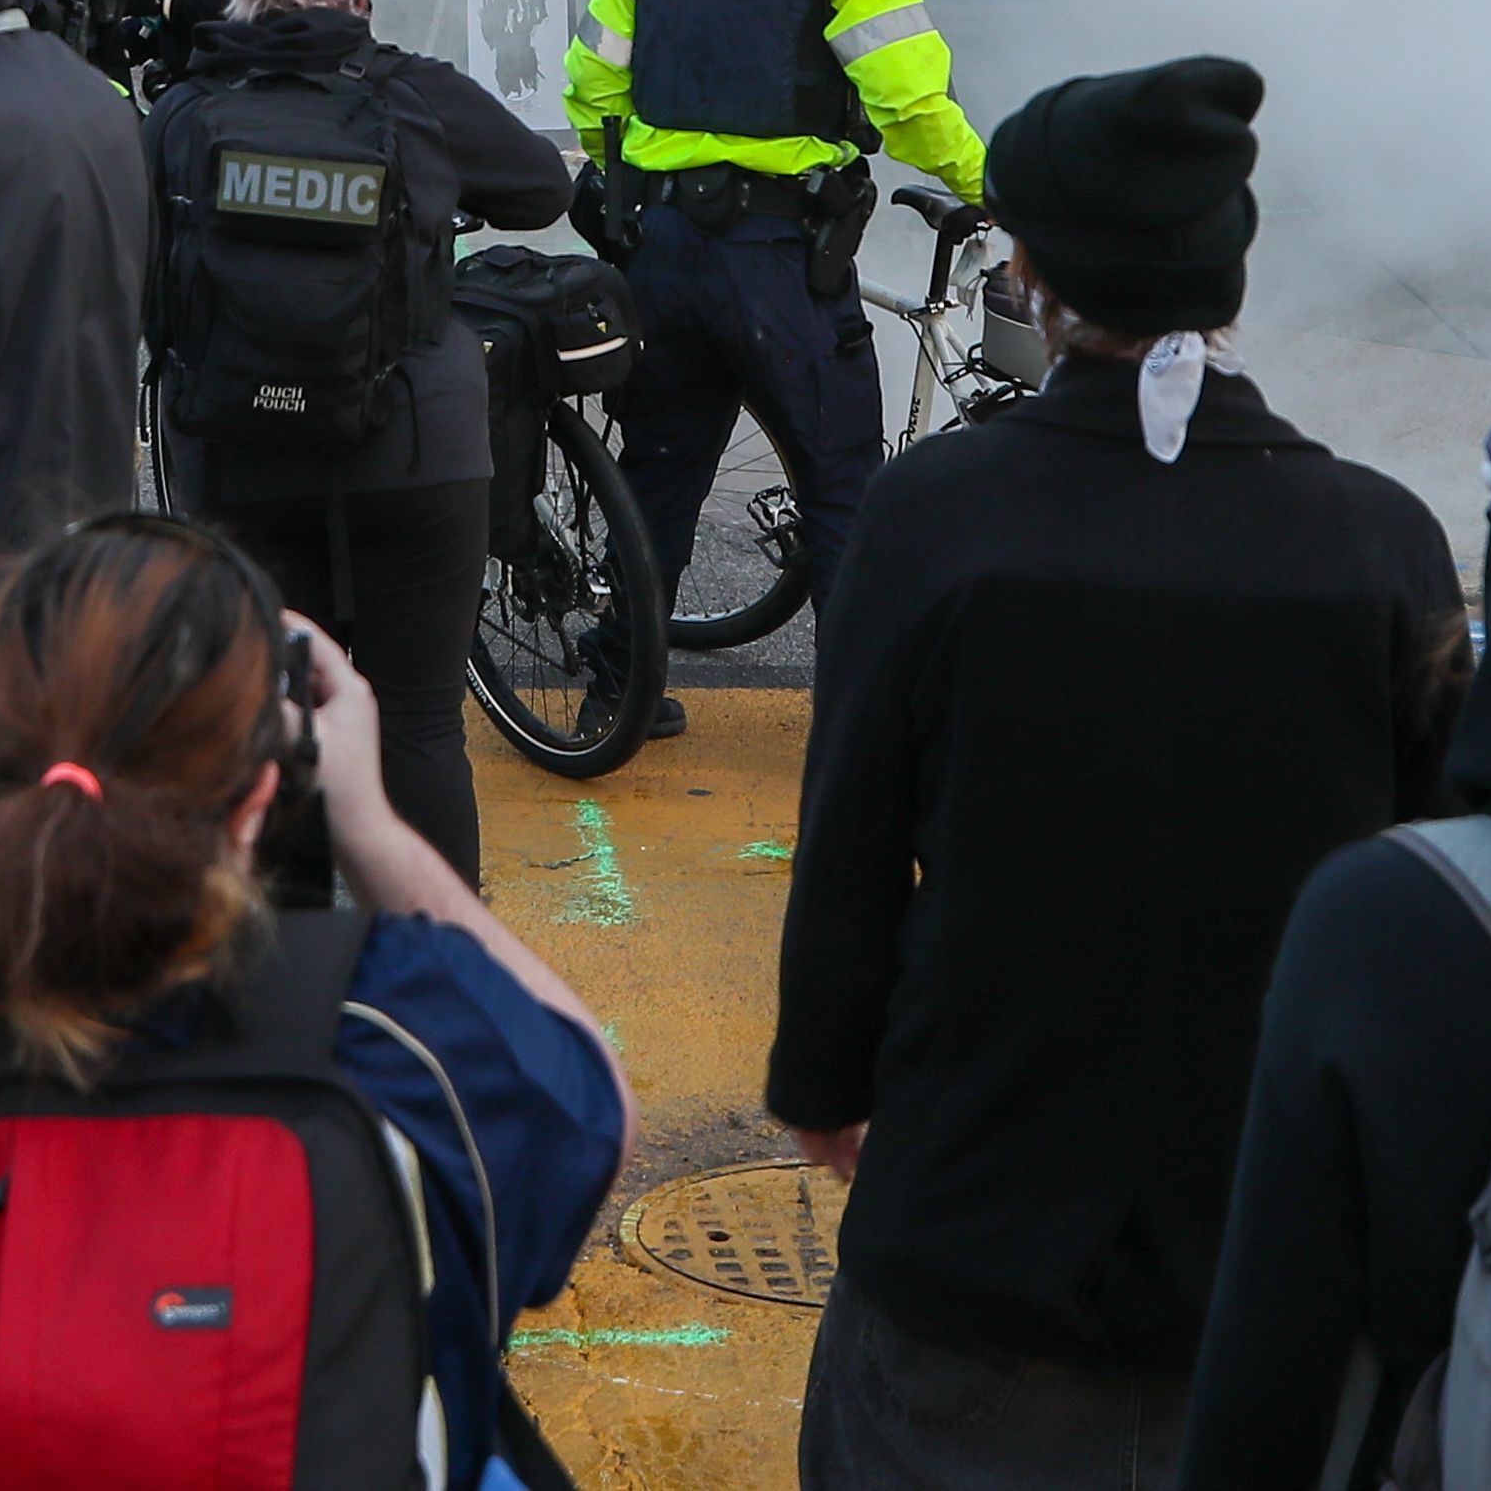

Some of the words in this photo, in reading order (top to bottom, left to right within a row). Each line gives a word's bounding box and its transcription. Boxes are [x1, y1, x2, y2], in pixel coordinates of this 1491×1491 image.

[223, 161, 379, 216] MEDIC
[260, 384, 303, 399] OUCH
[253, 396, 306, 413] POUCH
